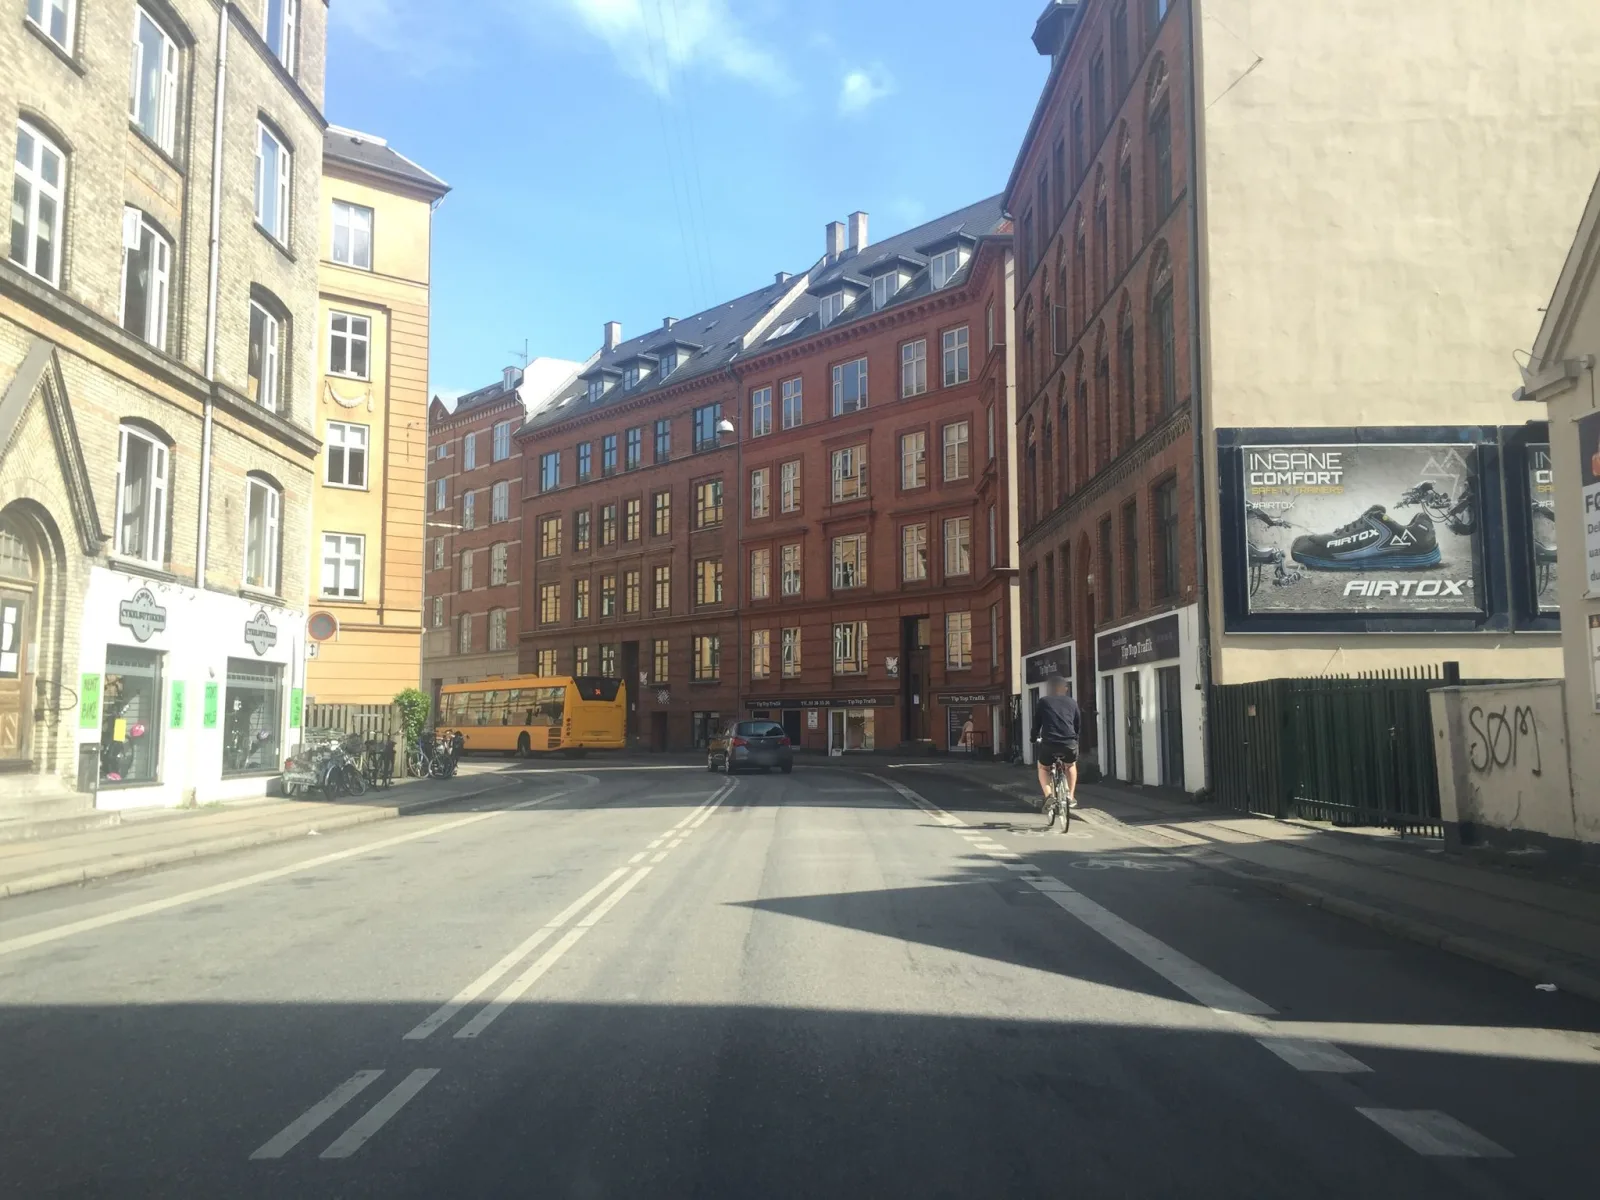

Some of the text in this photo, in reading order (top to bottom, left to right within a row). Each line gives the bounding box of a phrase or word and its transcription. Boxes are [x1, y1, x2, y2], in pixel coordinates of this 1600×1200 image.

[1249, 452, 1343, 470] INSANE
[1250, 471, 1344, 485] COMFORT
[1251, 485, 1345, 495] SAFETY TRAINERS
[1252, 501, 1295, 509] #AIRTOX
[1326, 528, 1380, 548] AIRTOX
